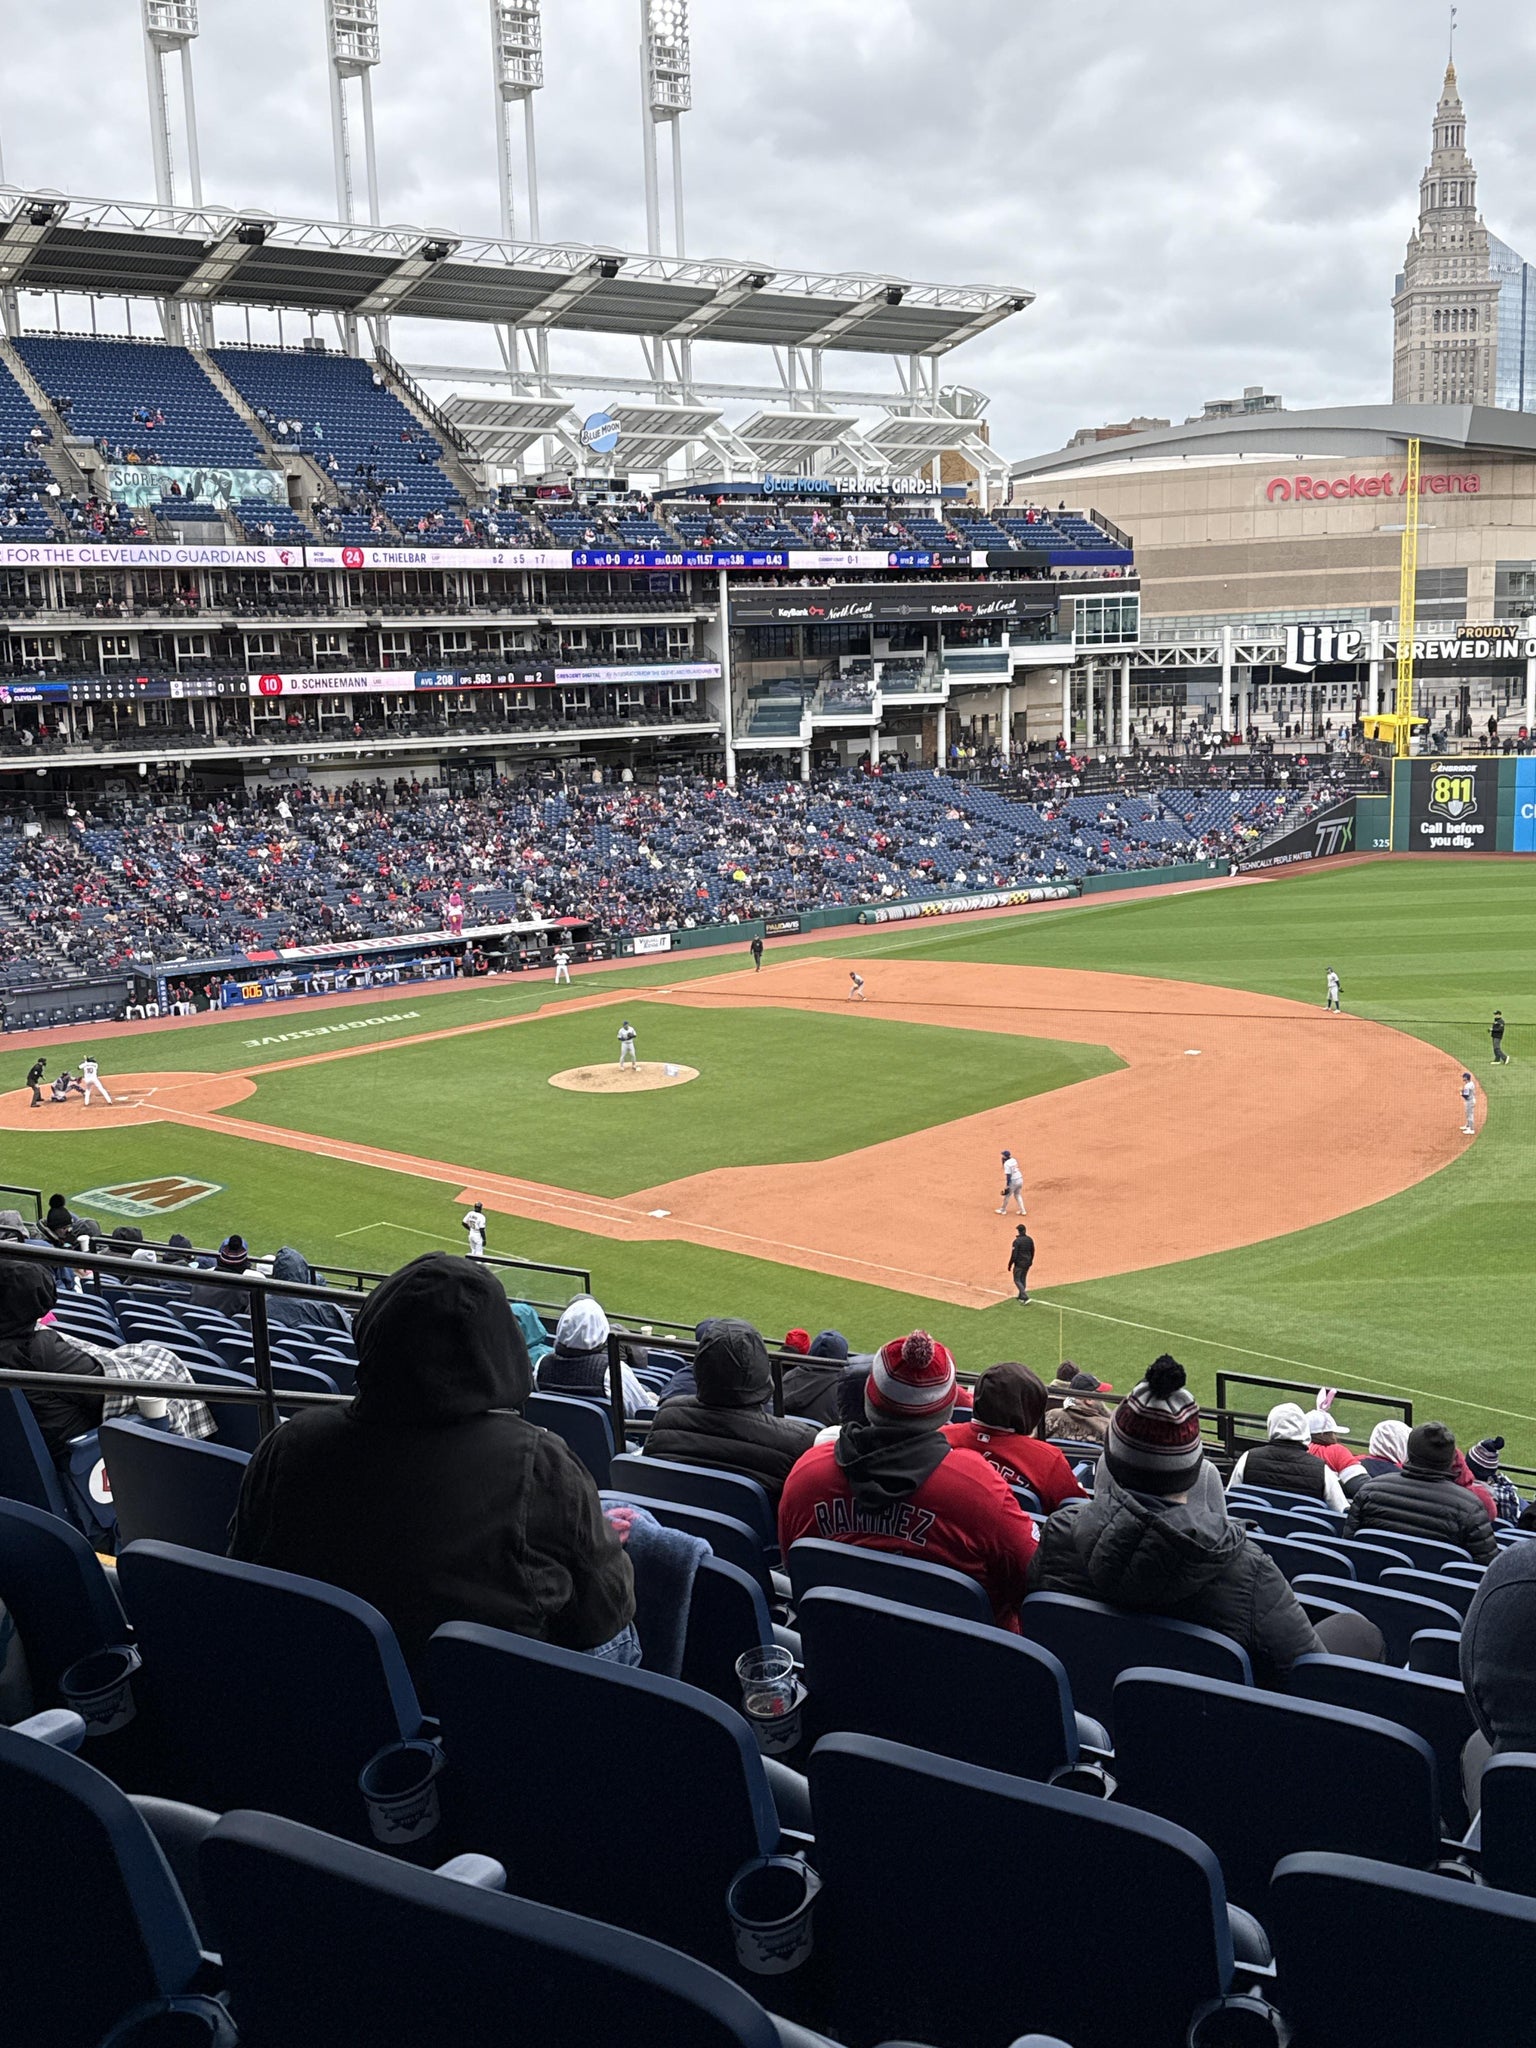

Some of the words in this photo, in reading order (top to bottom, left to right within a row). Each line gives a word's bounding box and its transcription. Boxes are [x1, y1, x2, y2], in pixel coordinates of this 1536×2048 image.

[582, 430, 601, 444] BLUE
[602, 422, 620, 436] MOON
[114, 470, 159, 487] SCORE
[763, 473, 794, 495] BLUE
[797, 477, 830, 492] MOON
[835, 476, 889, 494] TERRACE
[892, 478, 942, 495] GARDEN
[1294, 472, 1393, 501] Rocket
[1399, 472, 1481, 495] Arena
[7, 548, 41, 562] FOR
[43, 548, 75, 562] THE
[79, 548, 172, 562] CLEVELAND
[176, 549, 266, 563] GUARDIANS
[345, 550, 360, 564] 24
[372, 552, 382, 564] C.
[382, 552, 427, 564] THIELBAR
[520, 554, 525, 564] 5
[540, 554, 546, 564] 7
[581, 554, 588, 565] 3
[606, 554, 620, 565] 0-0
[634, 554, 645, 565] 2.1
[665, 554, 683, 565] 0.00
[696, 554, 714, 565] 11.57
[766, 554, 782, 565] 0.43
[847, 554, 859, 565] 0-1
[910, 555, 914, 565] 2
[925, 555, 930, 565] 2
[778, 608, 809, 618] KeyBank
[824, 604, 850, 621] North
[849, 602, 873, 616] Coast
[931, 604, 959, 615] KeyBank
[972, 601, 996, 617] North
[995, 598, 1017, 612] Coast
[1456, 626, 1519, 639] PROUDLY
[1281, 624, 1362, 674] Lite
[1396, 640, 1491, 661] BREWED
[1495, 639, 1520, 659] IN
[264, 678, 278, 692] 10
[290, 679, 300, 690] D.
[302, 677, 368, 689] SCHNEEMANN
[420, 678, 434, 686] AVG
[434, 674, 454, 686] .208
[460, 676, 472, 685] OPS
[508, 672, 515, 684] 0
[536, 671, 542, 683] 2
[218, 683, 225, 693] 0
[240, 682, 247, 692] 0
[1437, 764, 1478, 773] ENBRIDGE
[1434, 777, 1472, 804] 811
[1420, 822, 1443, 834] Call
[1446, 822, 1485, 834] before
[1372, 838, 1390, 848] 325
[1430, 838, 1451, 849] you
[1452, 834, 1475, 849] dig.
[1273, 854, 1293, 865] PEOPLE
[241, 1010, 421, 1049] PROGRESSIVE
